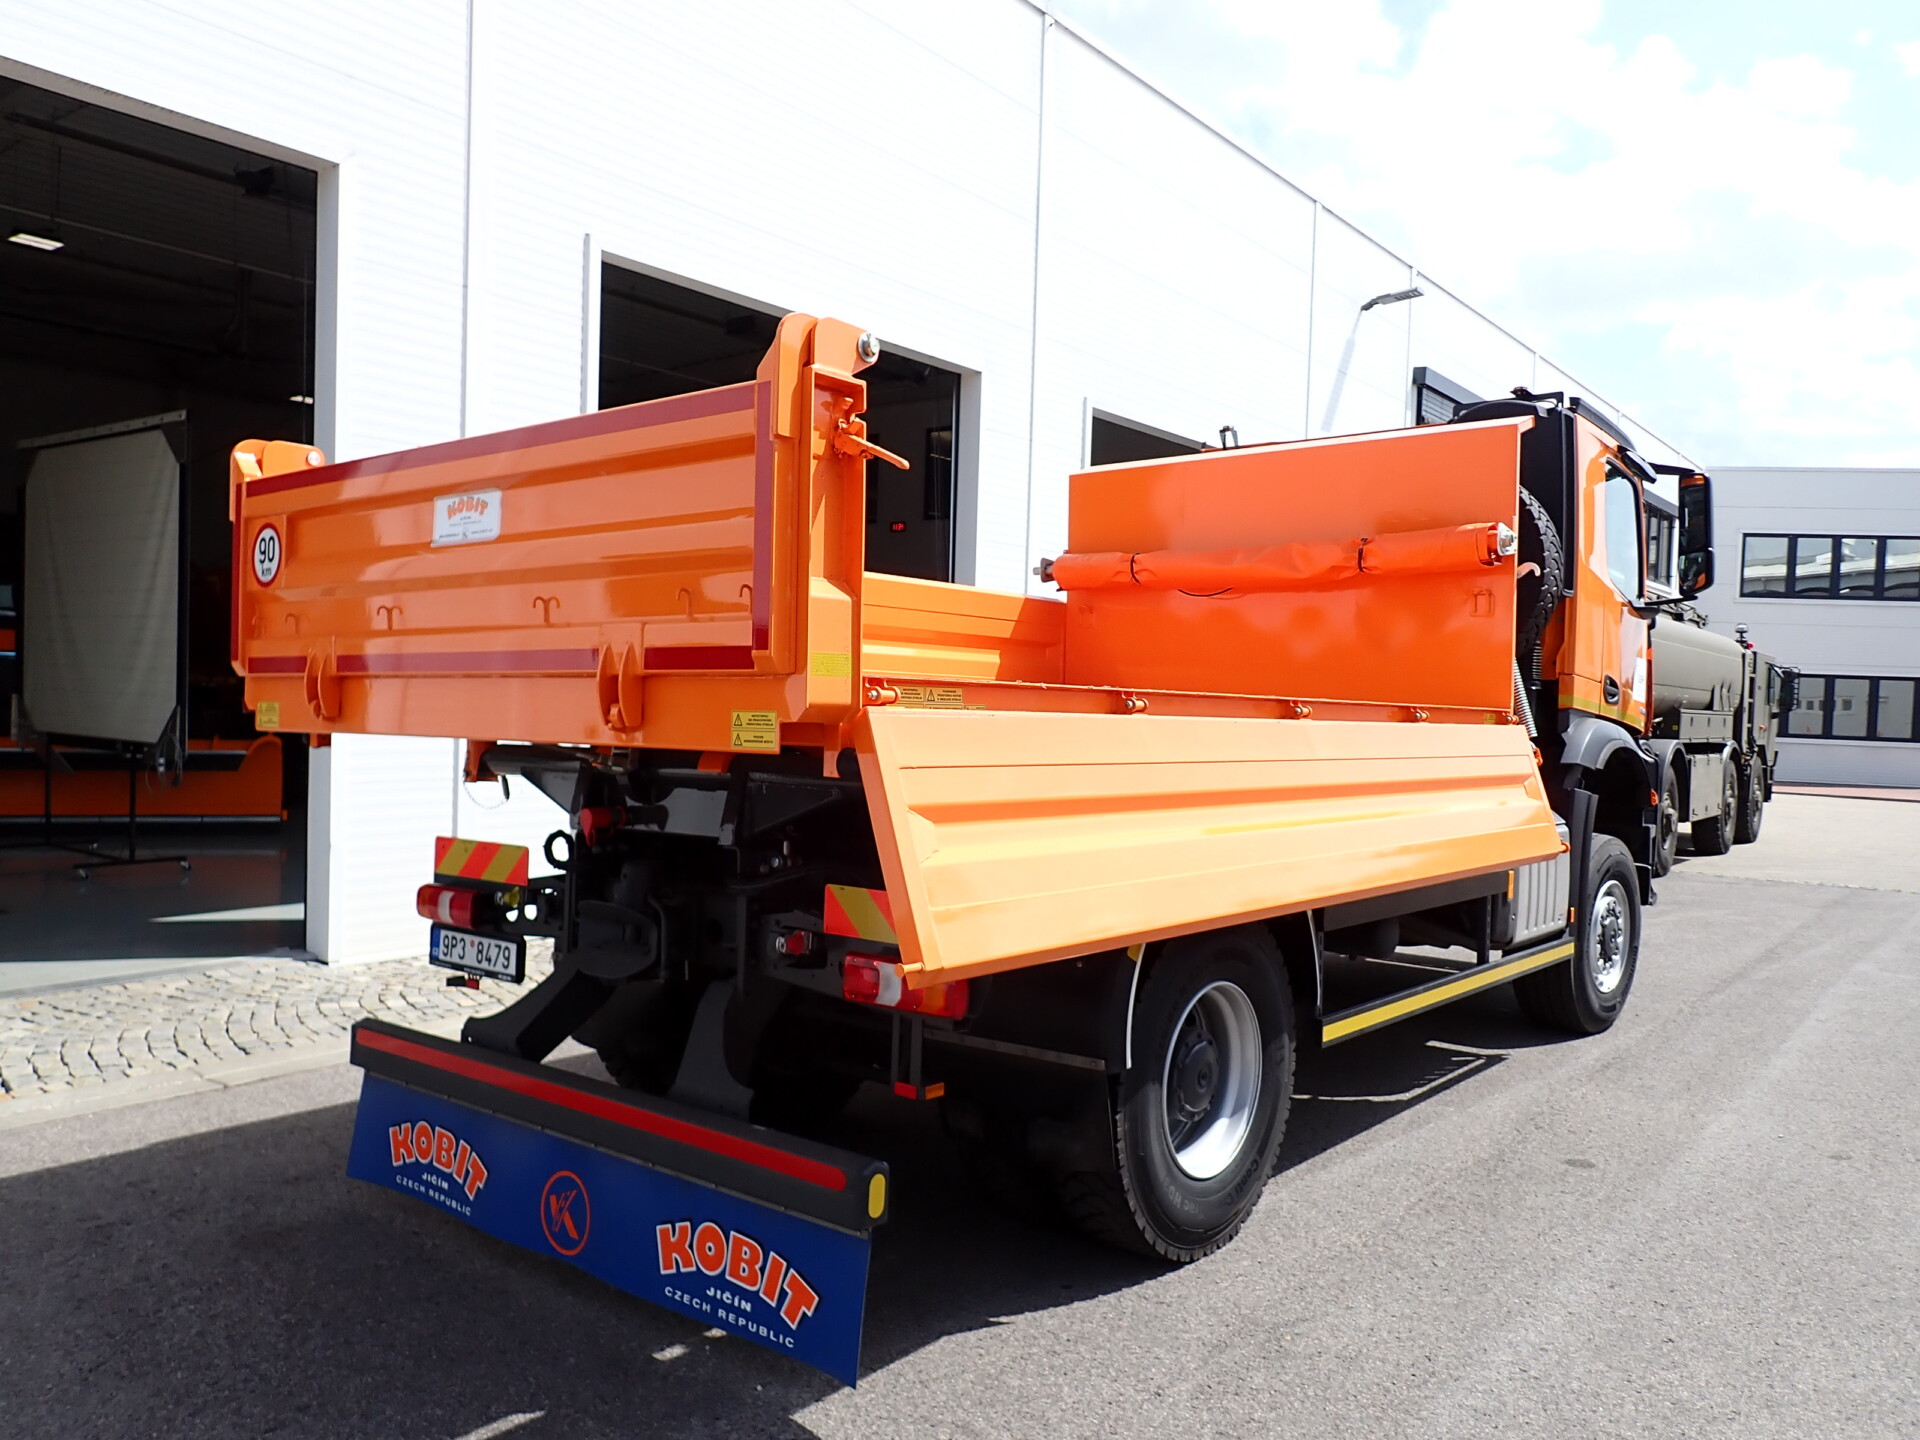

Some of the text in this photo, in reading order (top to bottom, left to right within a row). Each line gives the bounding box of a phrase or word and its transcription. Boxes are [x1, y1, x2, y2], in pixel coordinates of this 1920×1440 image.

[447, 495, 489, 521] KOBIT
[258, 535, 276, 564] 90
[261, 563, 272, 577] km
[441, 934, 512, 970] 9P3 8479
[388, 1120, 488, 1202] KOBIT
[395, 1174, 472, 1217] CZECH REPUBLIC
[656, 1221, 820, 1331] KOBIT
[664, 1286, 795, 1349] CZECH REPUBLIC
[706, 1286, 752, 1313] JIČÍN
